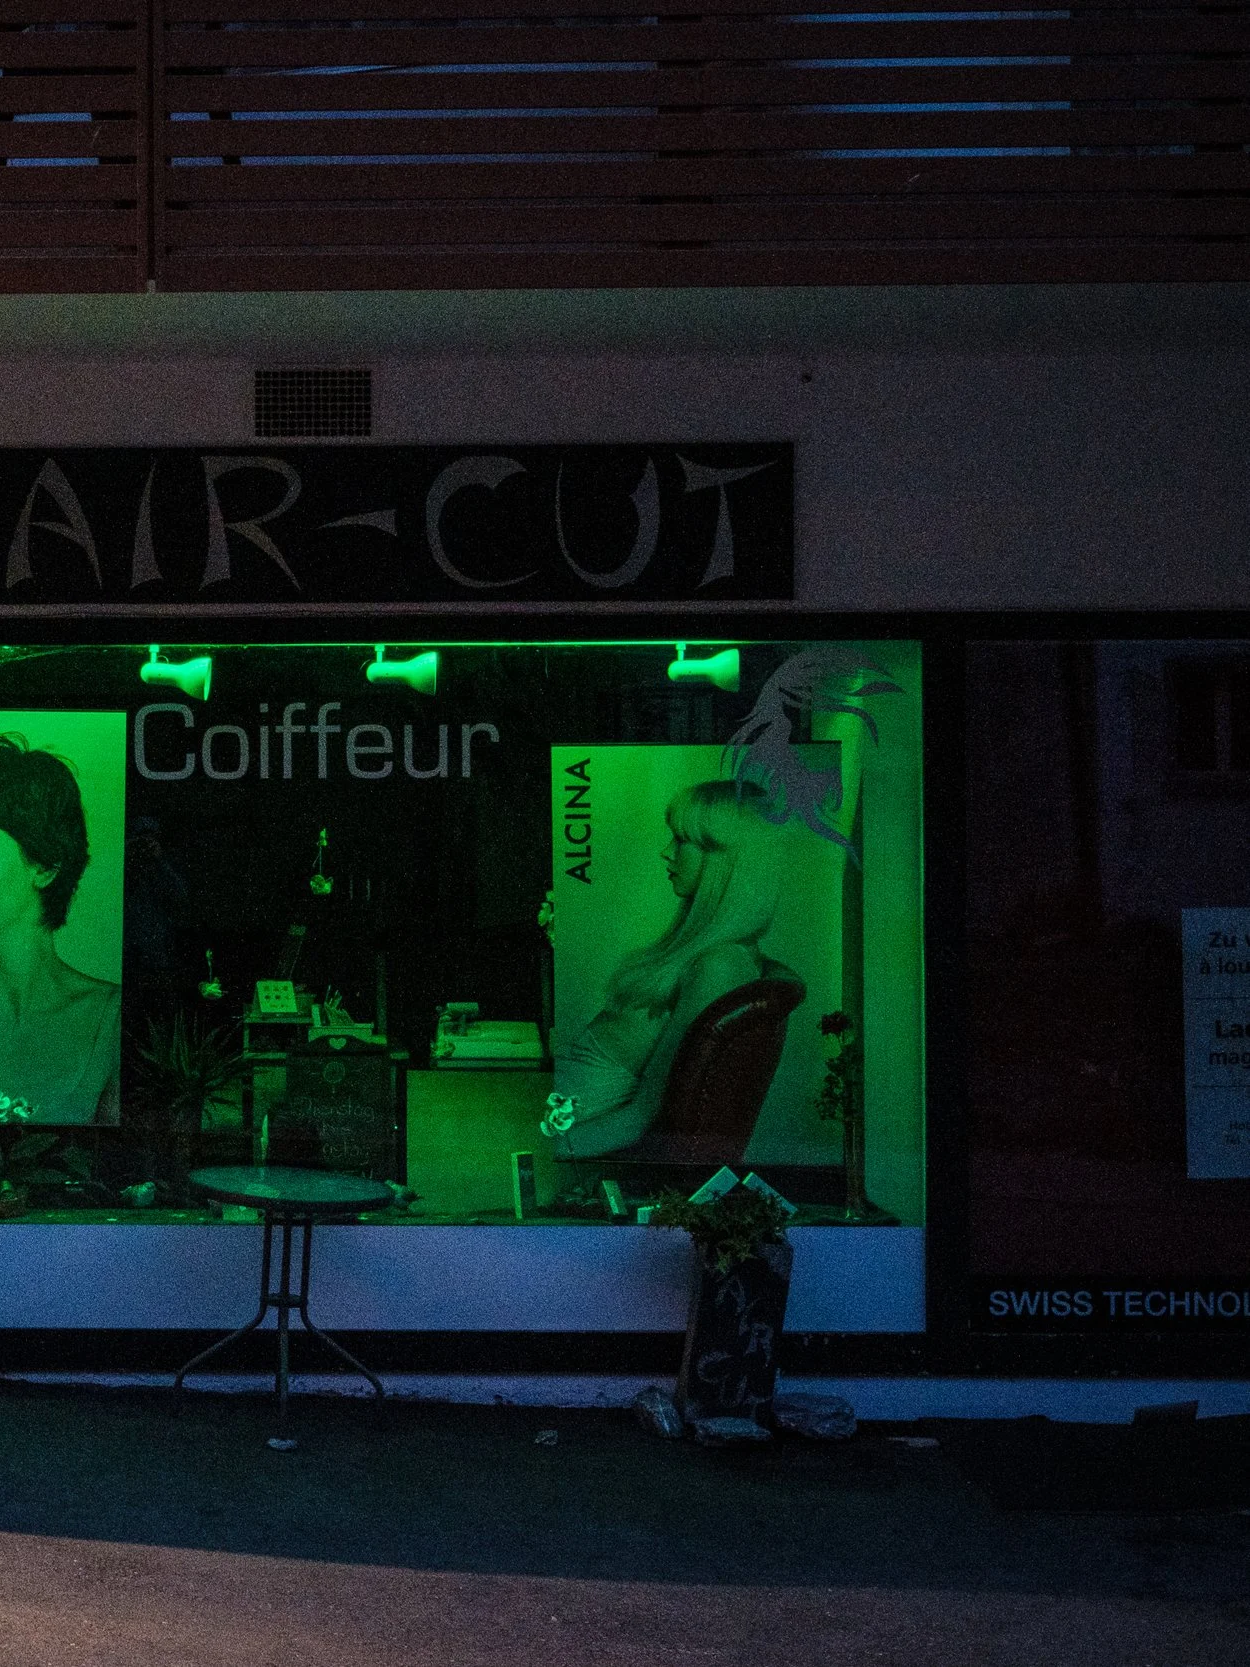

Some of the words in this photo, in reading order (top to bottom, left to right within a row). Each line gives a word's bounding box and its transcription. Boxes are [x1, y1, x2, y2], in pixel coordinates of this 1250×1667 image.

[134, 702, 500, 781] Coiffeur
[563, 758, 593, 885] ALCINA
[1208, 931, 1238, 949] Zu
[988, 1290, 1093, 1317] SWISS
